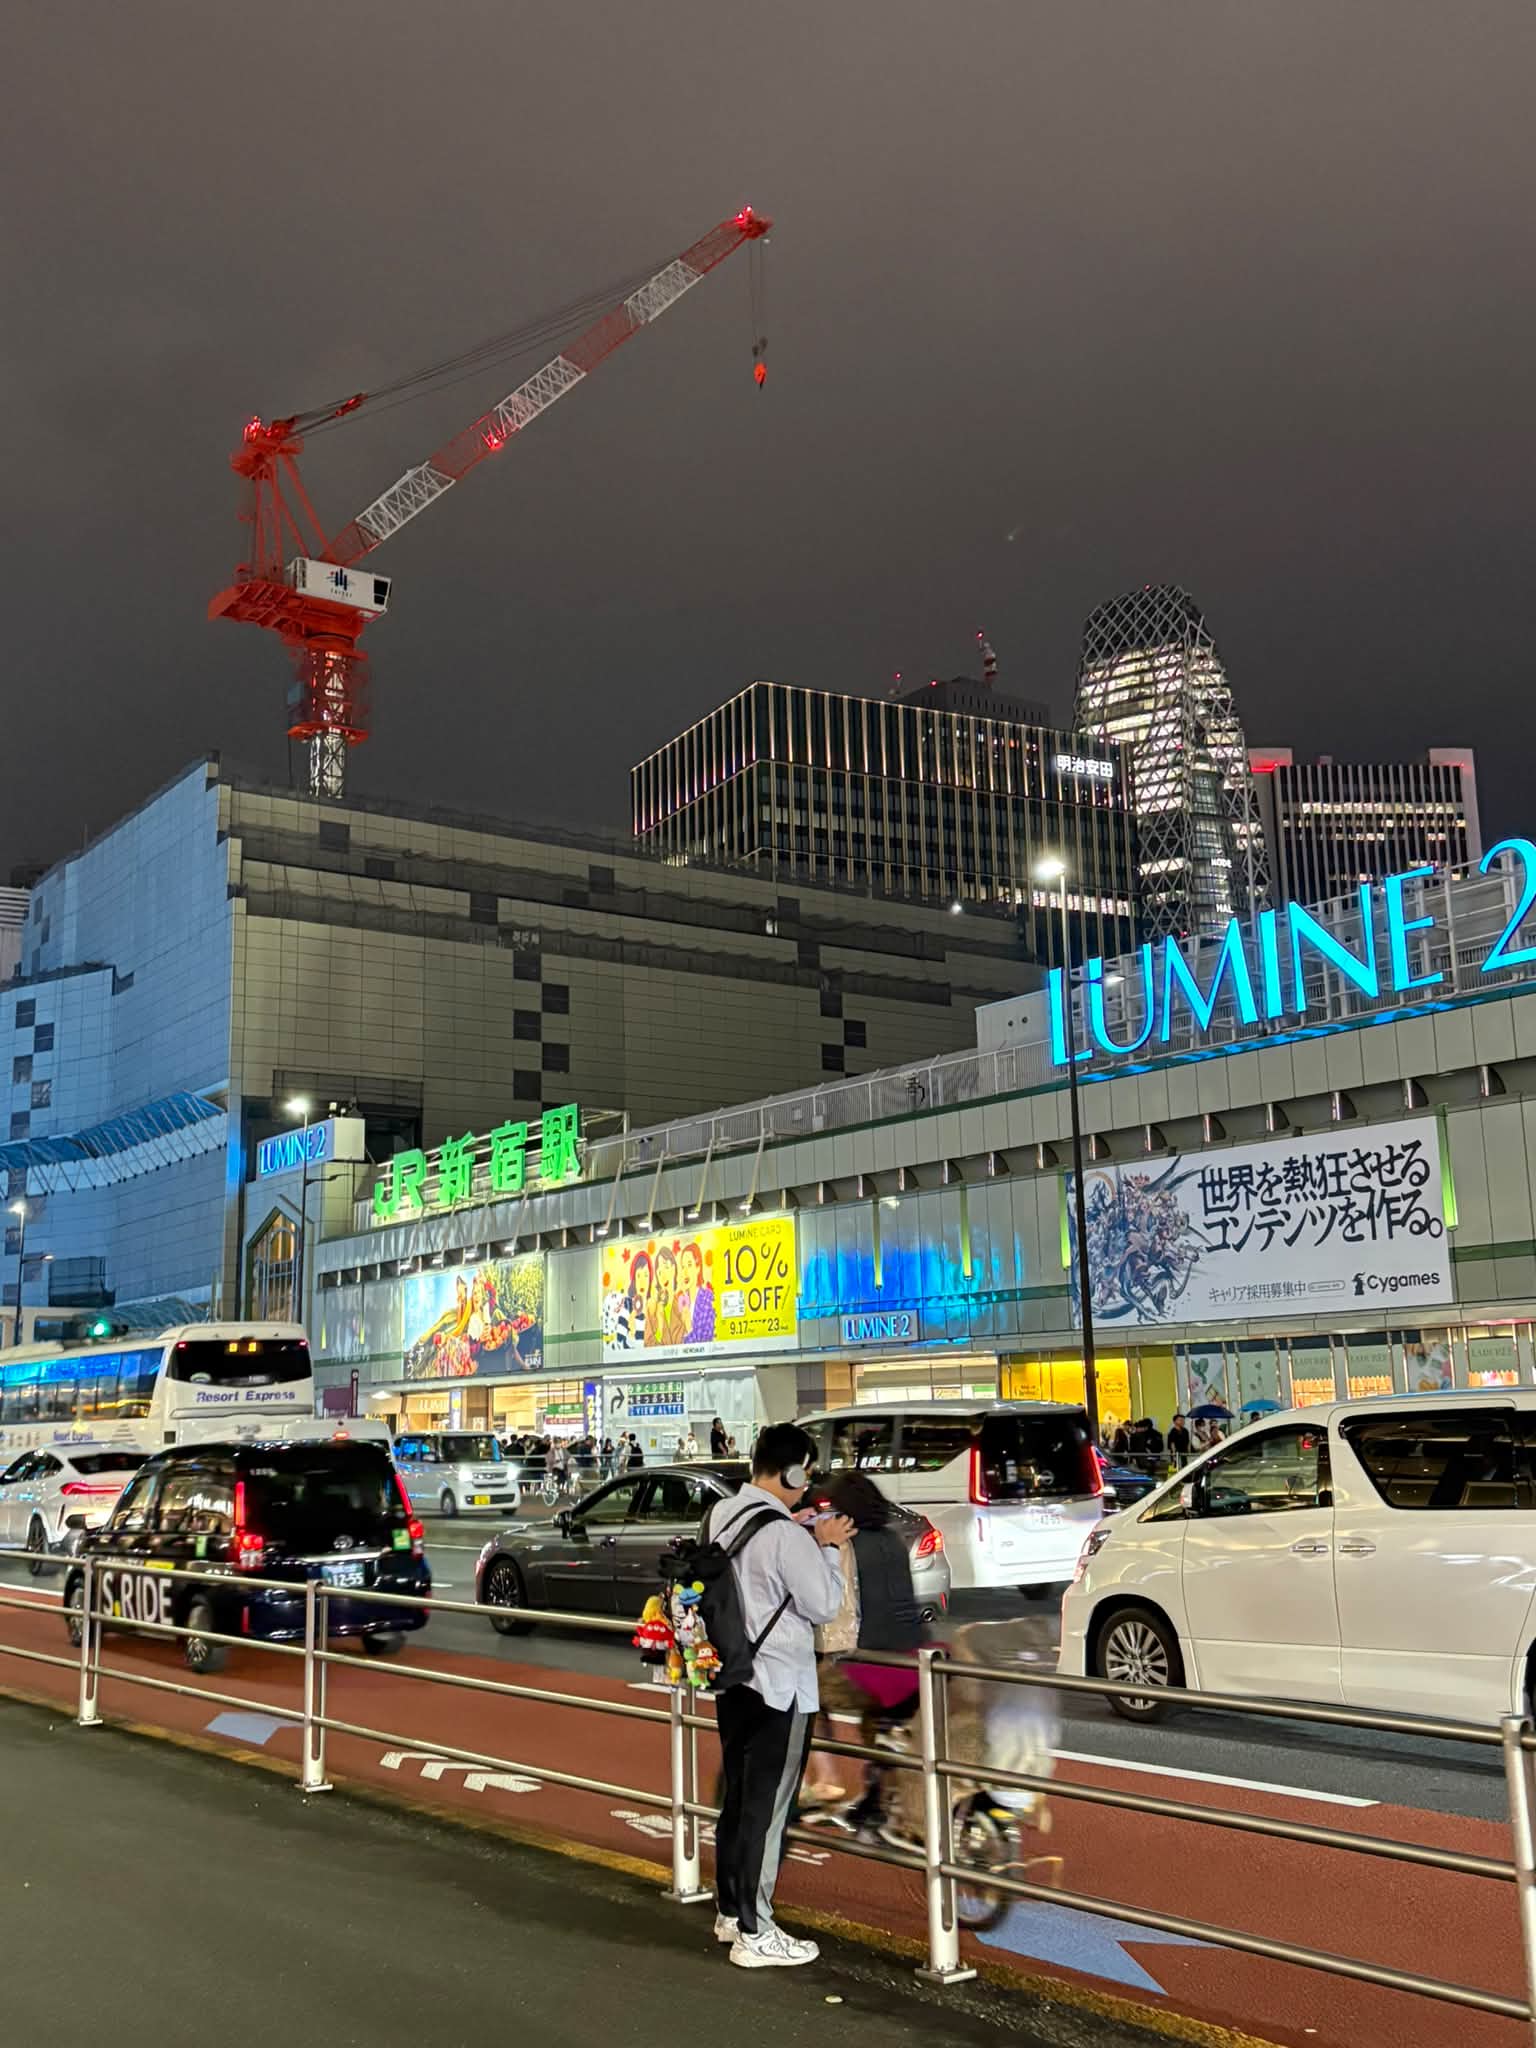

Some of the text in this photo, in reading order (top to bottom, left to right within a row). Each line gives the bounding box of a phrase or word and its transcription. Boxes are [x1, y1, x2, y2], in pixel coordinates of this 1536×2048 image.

[1056, 754, 1114, 779] 明治安田
[1210, 858, 1232, 869] MODE
[1215, 903, 1235, 914] HAL
[1047, 837, 1536, 1066] LUMINE 2
[259, 1126, 326, 1175] LUMINE 2
[373, 1102, 583, 1217] JR新宿駅
[1197, 1139, 1431, 1216] 世界を熱狂させる
[729, 1224, 781, 1241] LUMINE CARD
[1203, 1188, 1443, 1253] コンテンツを作る。
[724, 1241, 789, 1285] 10%
[1208, 1280, 1307, 1303] キャリア採用募集中
[1366, 1271, 1440, 1293] Cygames
[748, 1285, 784, 1312] OFF
[730, 1317, 780, 1335] 9.17 23
[844, 1314, 910, 1341] LUMINE 2
[196, 1390, 295, 1403] Resort Express
[103, 1570, 174, 1626] S.RIDE
